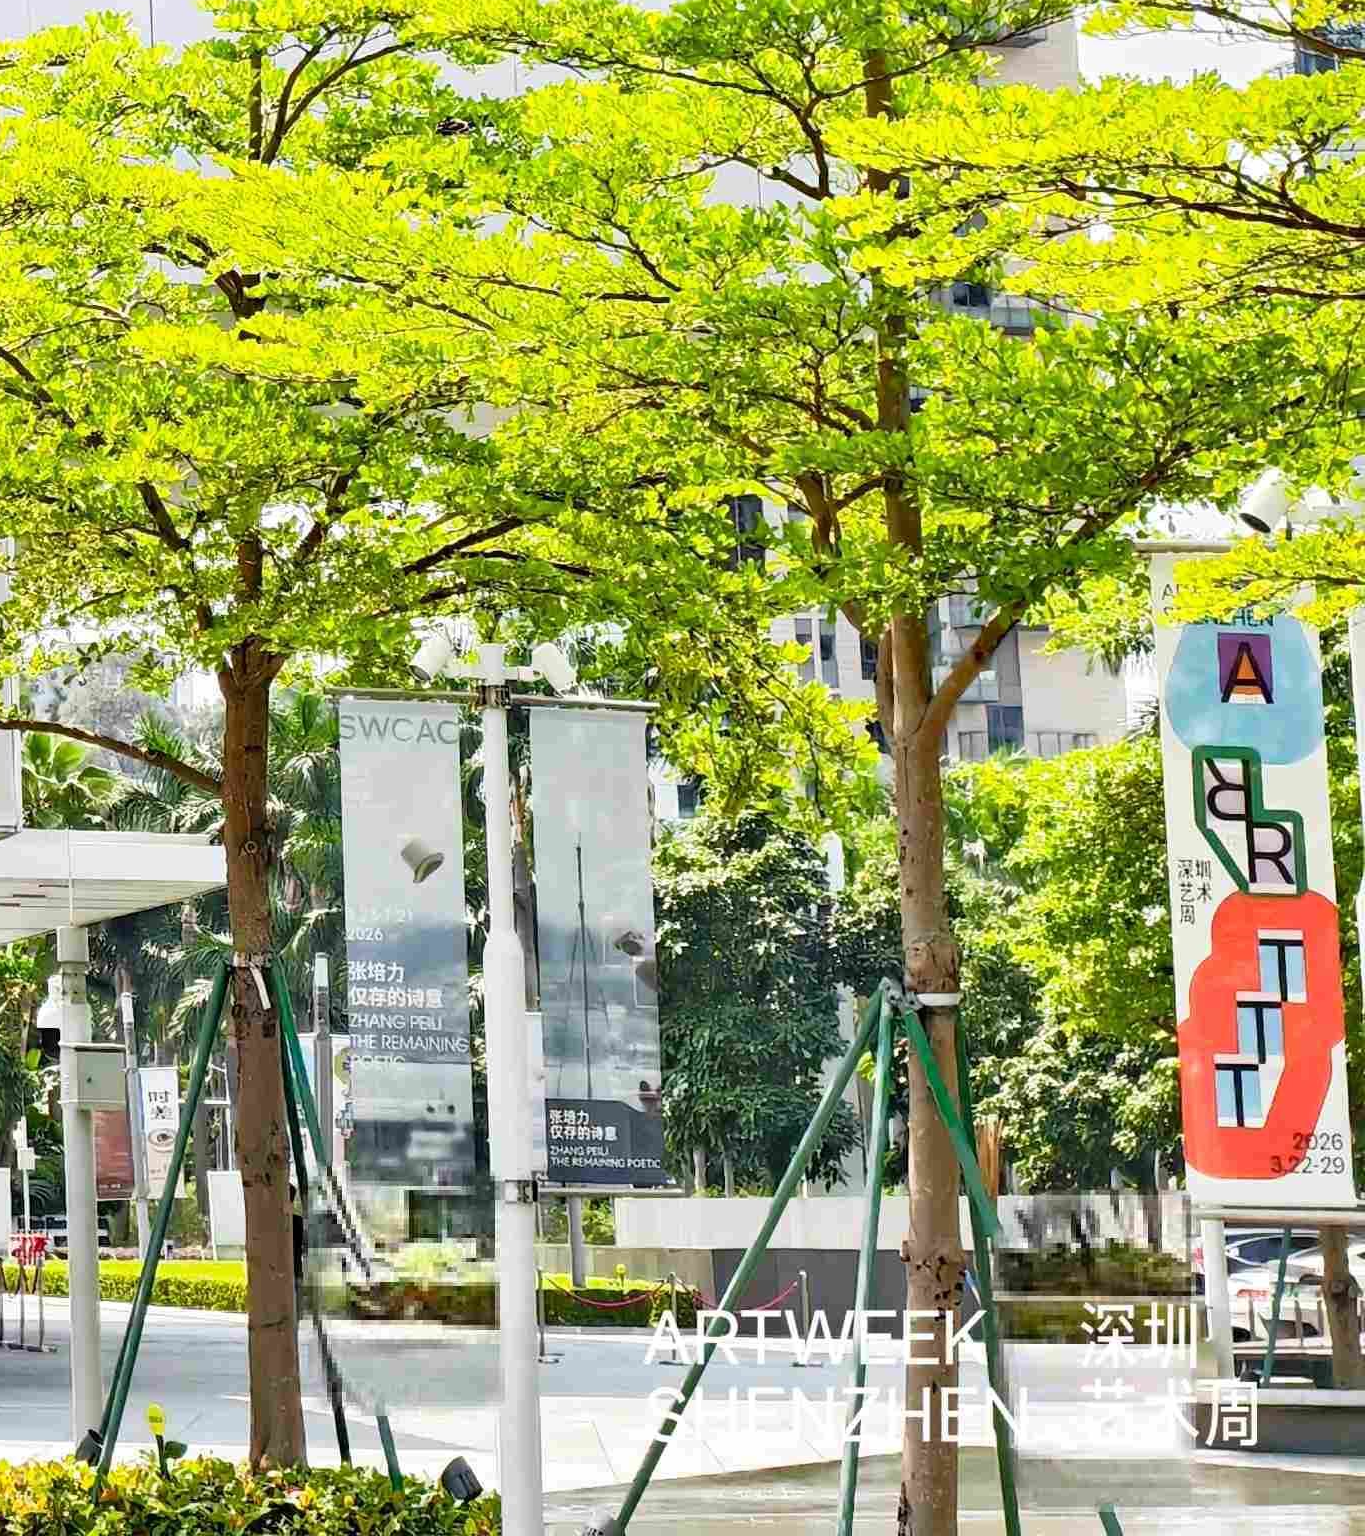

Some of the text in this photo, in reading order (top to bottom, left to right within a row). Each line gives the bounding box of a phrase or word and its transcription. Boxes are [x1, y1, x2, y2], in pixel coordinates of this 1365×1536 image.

[341, 714, 459, 745] SWCAC
[345, 927, 384, 941] 2026
[348, 962, 405, 984] 张培力
[349, 986, 445, 1009] 仅存的诗意
[349, 1014, 406, 1029] ZHANG
[349, 1034, 469, 1053] THE REMAINING
[1292, 1133, 1343, 1151] 2026
[627, 1159, 661, 1169] POETIC
[1270, 1156, 1346, 1174] 3.22-29
